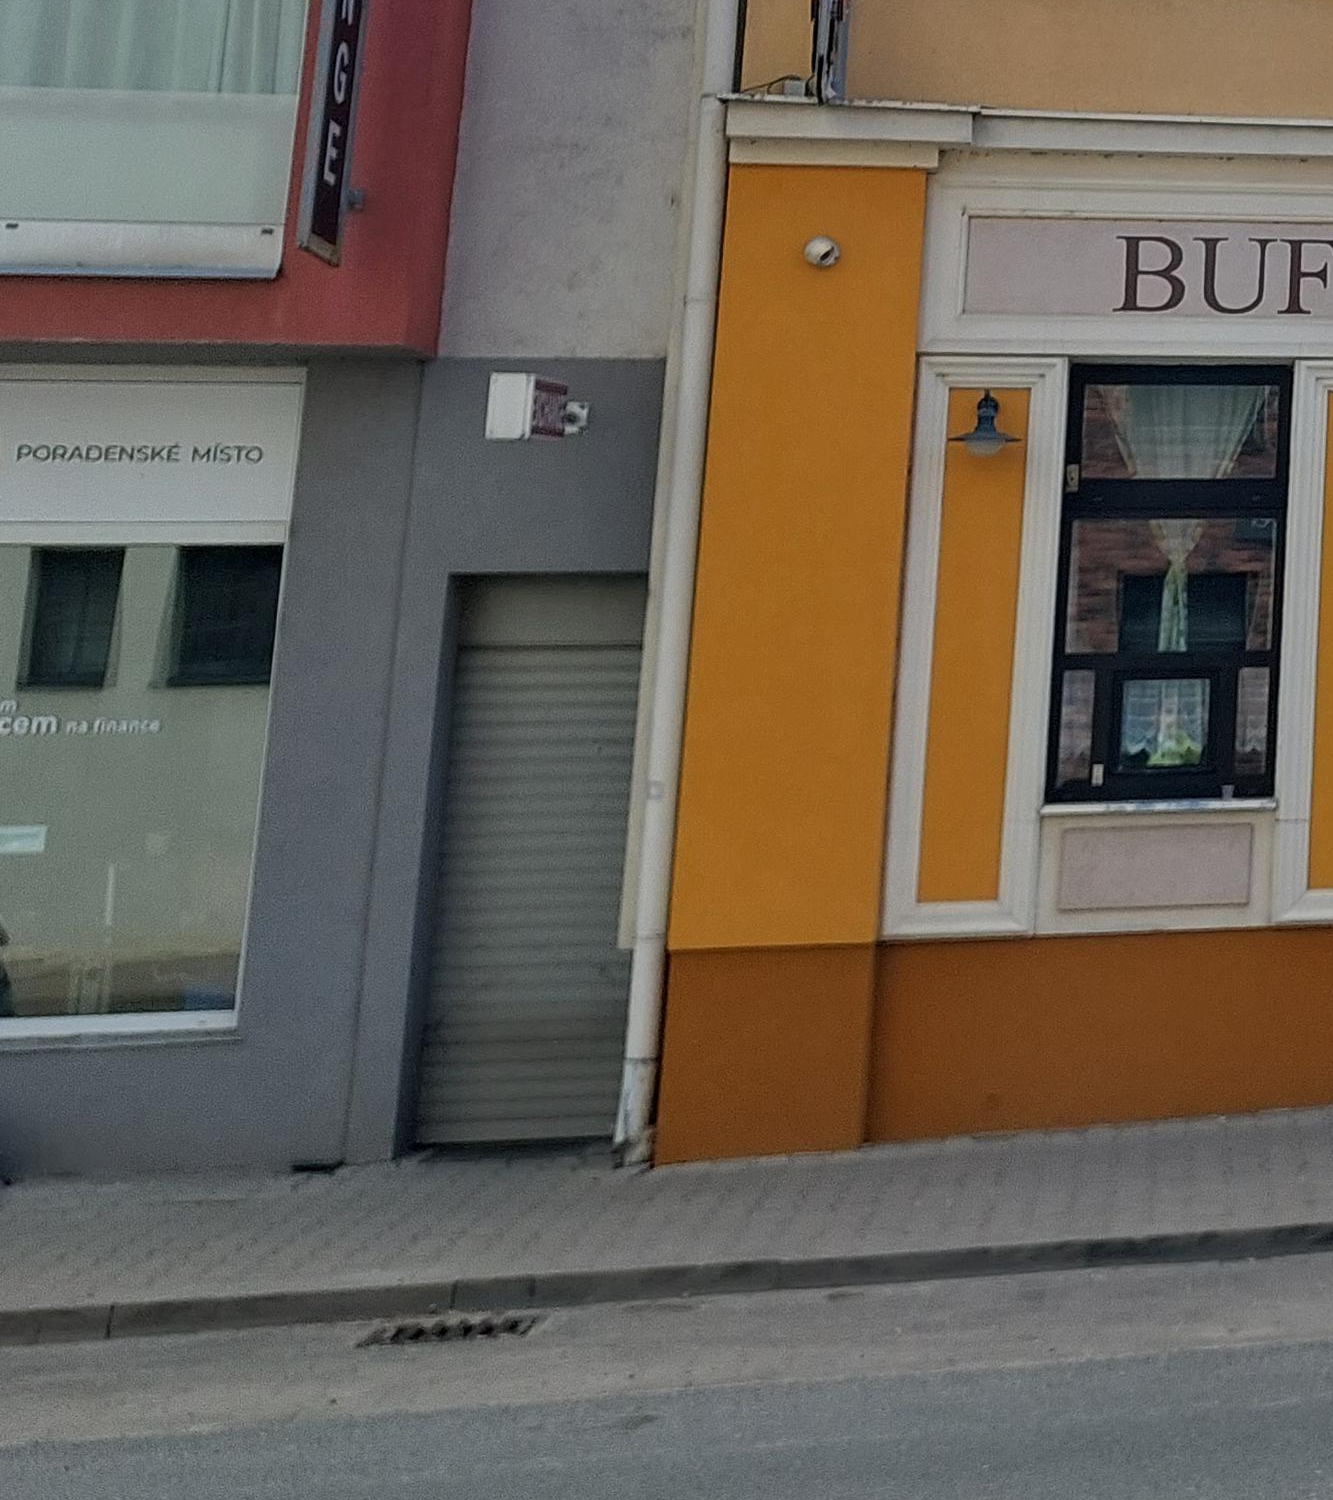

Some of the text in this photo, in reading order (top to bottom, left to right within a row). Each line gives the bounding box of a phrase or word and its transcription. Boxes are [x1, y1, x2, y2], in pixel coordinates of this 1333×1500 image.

[16, 442, 263, 465] PORADENSKÉ MÍSTO
[66, 720, 89, 736] na
[93, 717, 162, 735] finance
